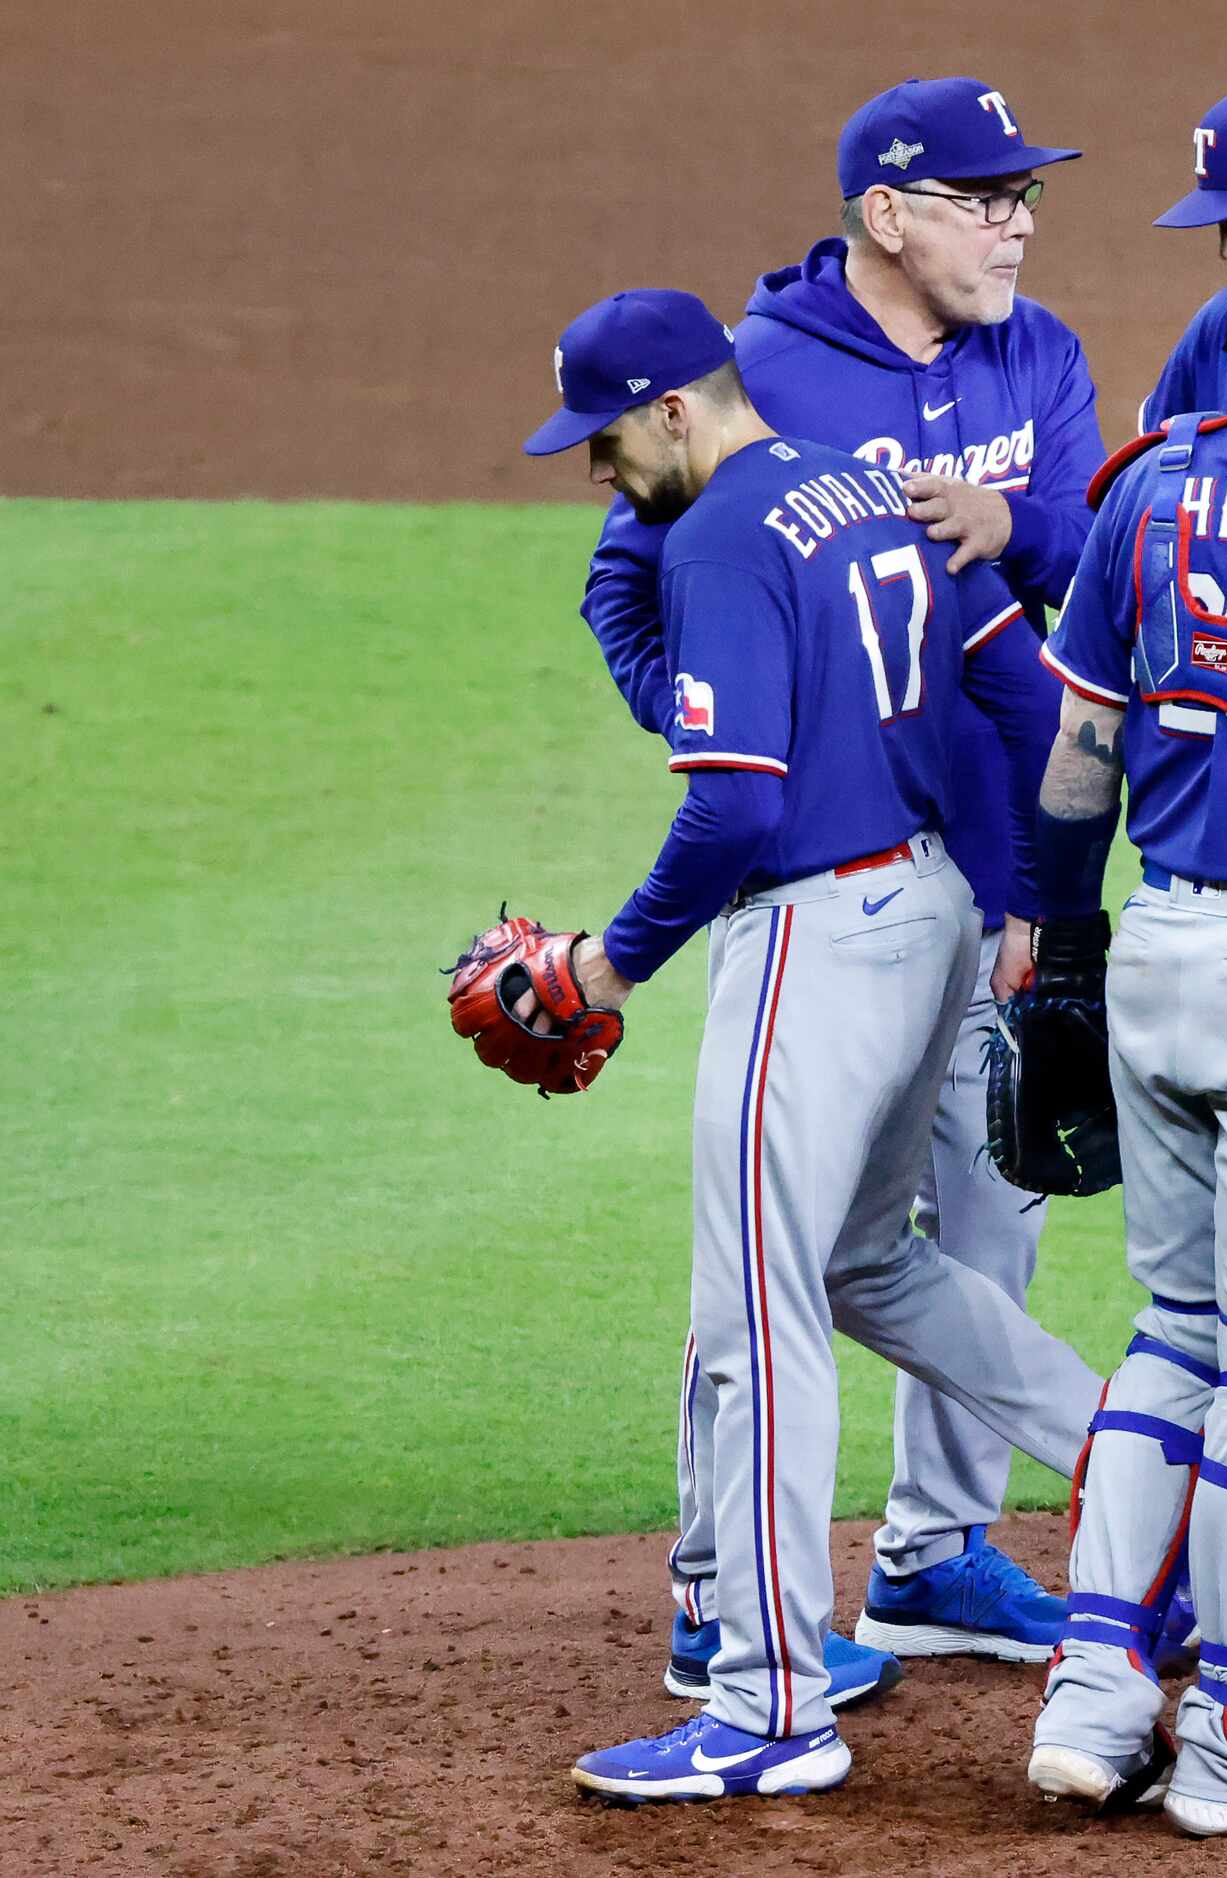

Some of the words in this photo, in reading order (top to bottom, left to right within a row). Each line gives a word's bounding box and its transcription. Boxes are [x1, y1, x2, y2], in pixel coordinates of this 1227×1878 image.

[977, 90, 1018, 136] T
[1193, 128, 1216, 177] T
[847, 545, 931, 724] 17
